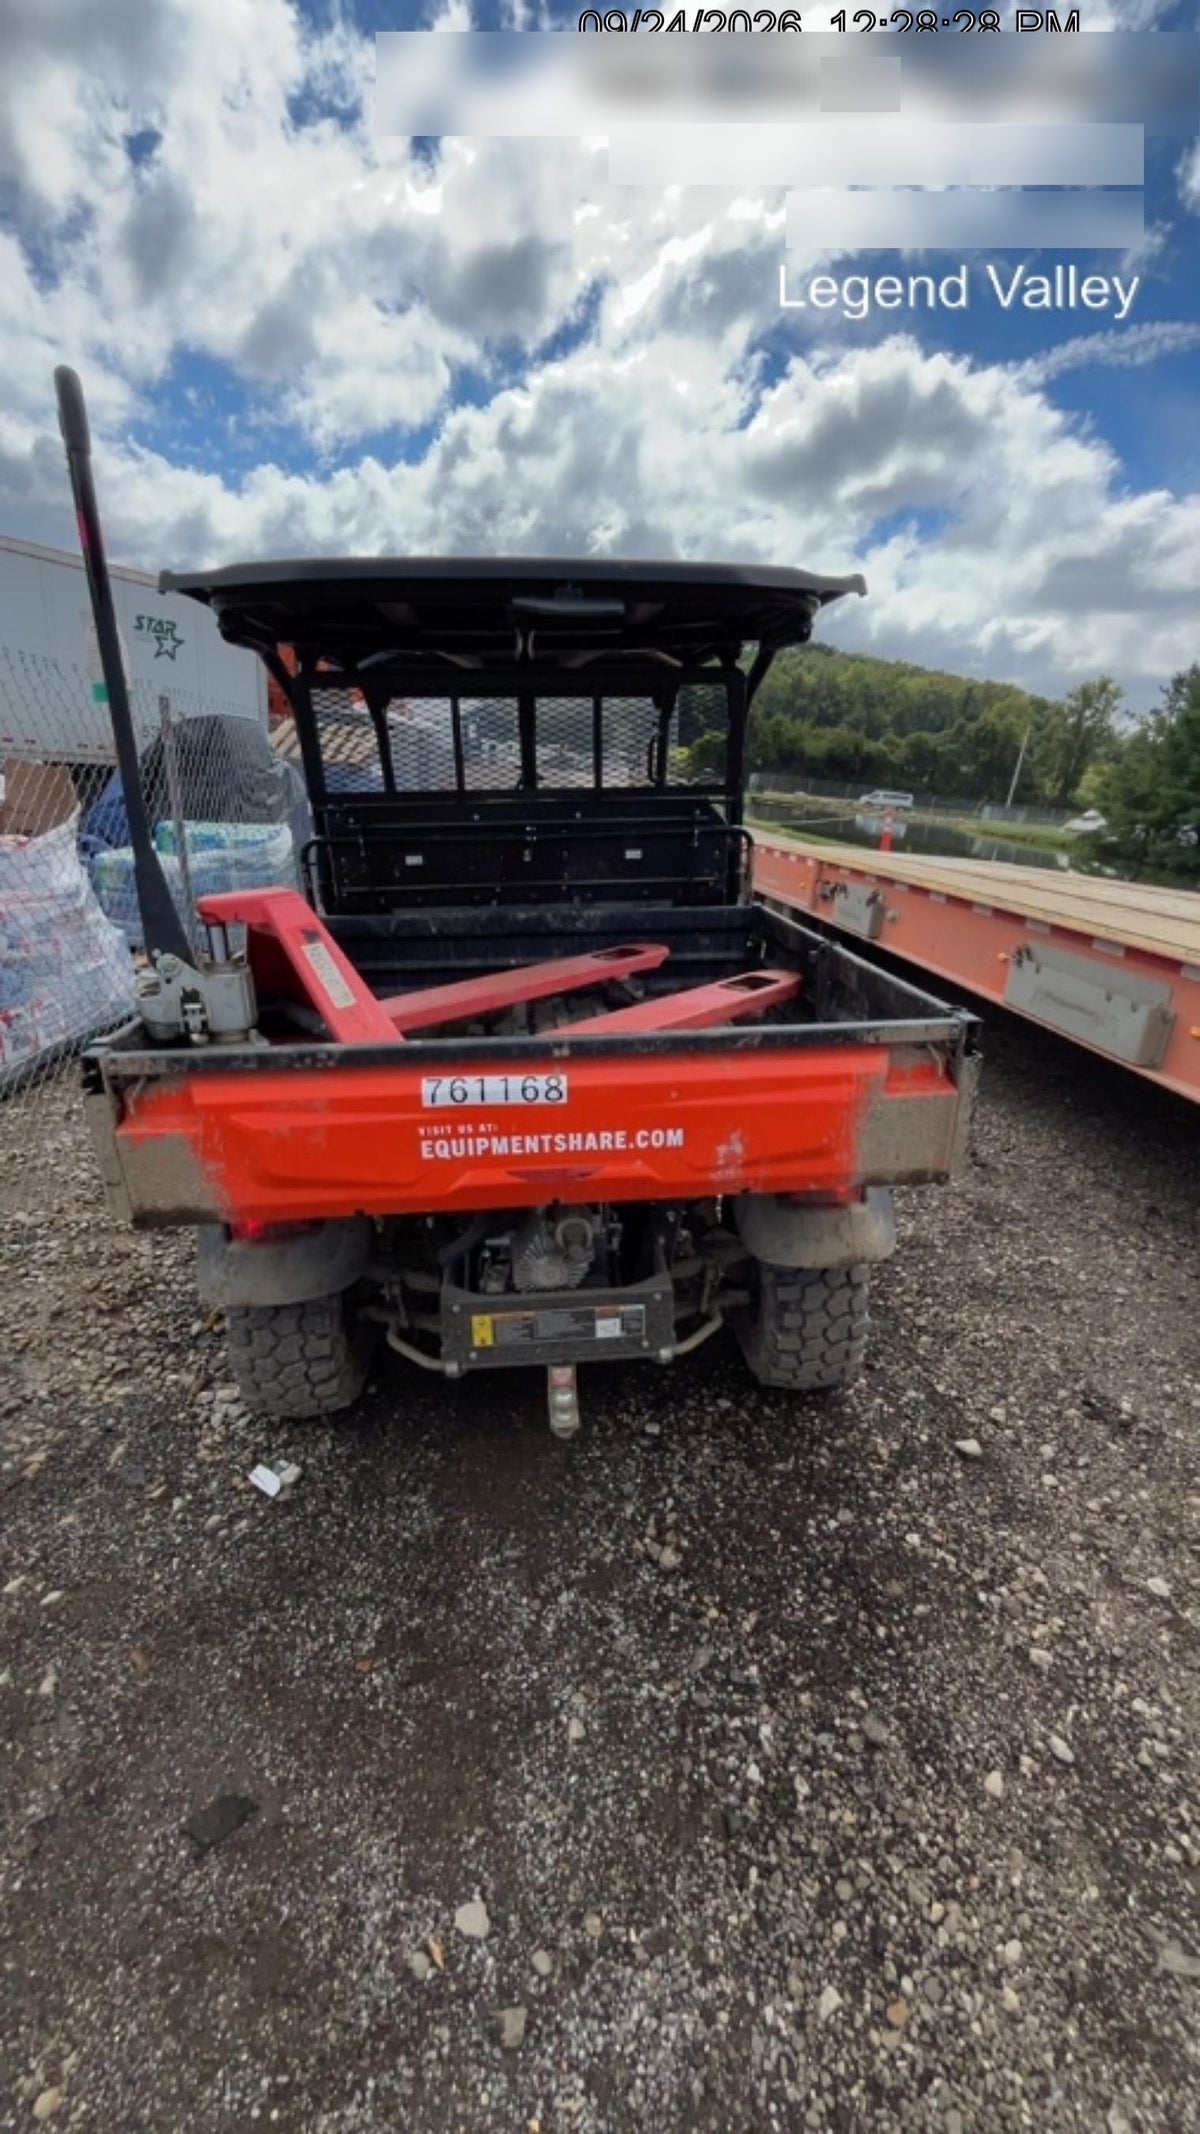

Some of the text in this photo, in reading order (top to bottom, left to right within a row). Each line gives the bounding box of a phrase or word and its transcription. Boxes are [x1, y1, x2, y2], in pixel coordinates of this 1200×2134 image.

[133, 614, 176, 637] STAR
[425, 1075, 564, 1104] 761168
[417, 1124, 452, 1136] VISIT
[457, 1123, 473, 1134] US
[421, 1128, 685, 1159] EQUIPMENTSHARE.COM
